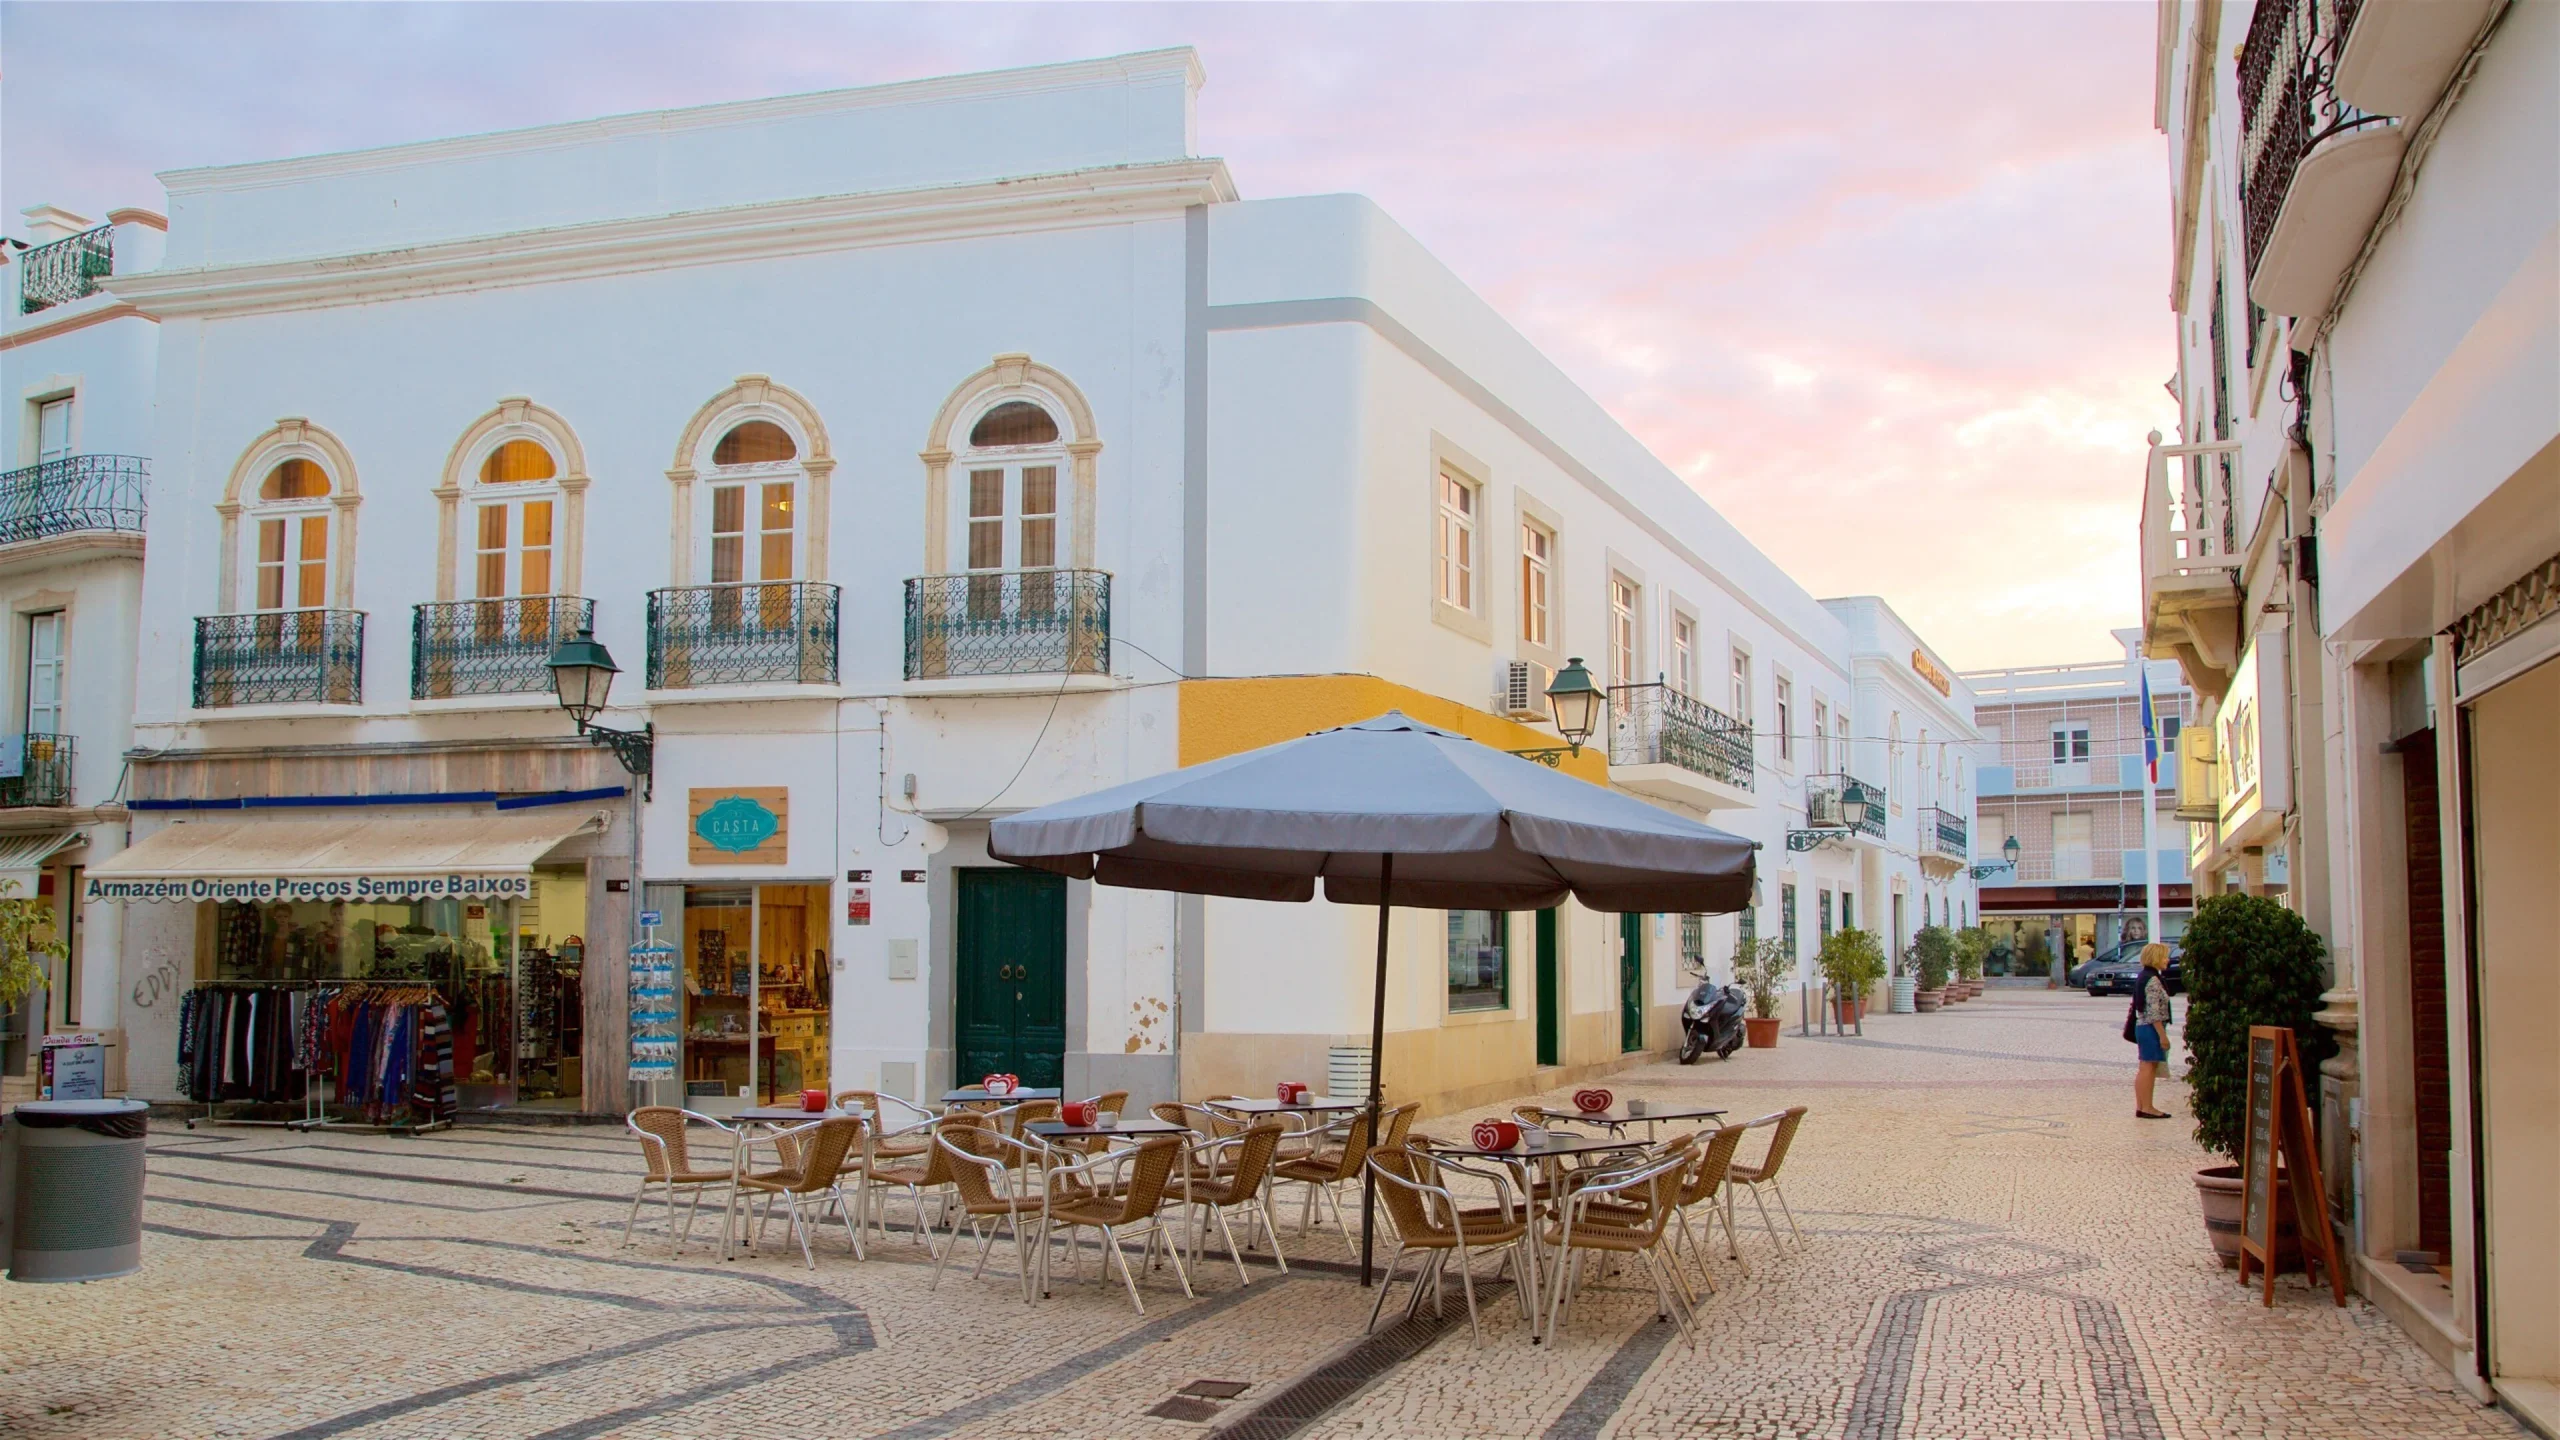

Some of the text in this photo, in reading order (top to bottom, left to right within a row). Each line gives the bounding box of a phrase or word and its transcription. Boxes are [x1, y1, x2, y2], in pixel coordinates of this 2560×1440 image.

[713, 820, 760, 834] CASTA
[861, 872, 872, 881] 23
[914, 872, 926, 881] 25
[88, 873, 527, 898] Armazém Oriente Preços Sempre Baixos
